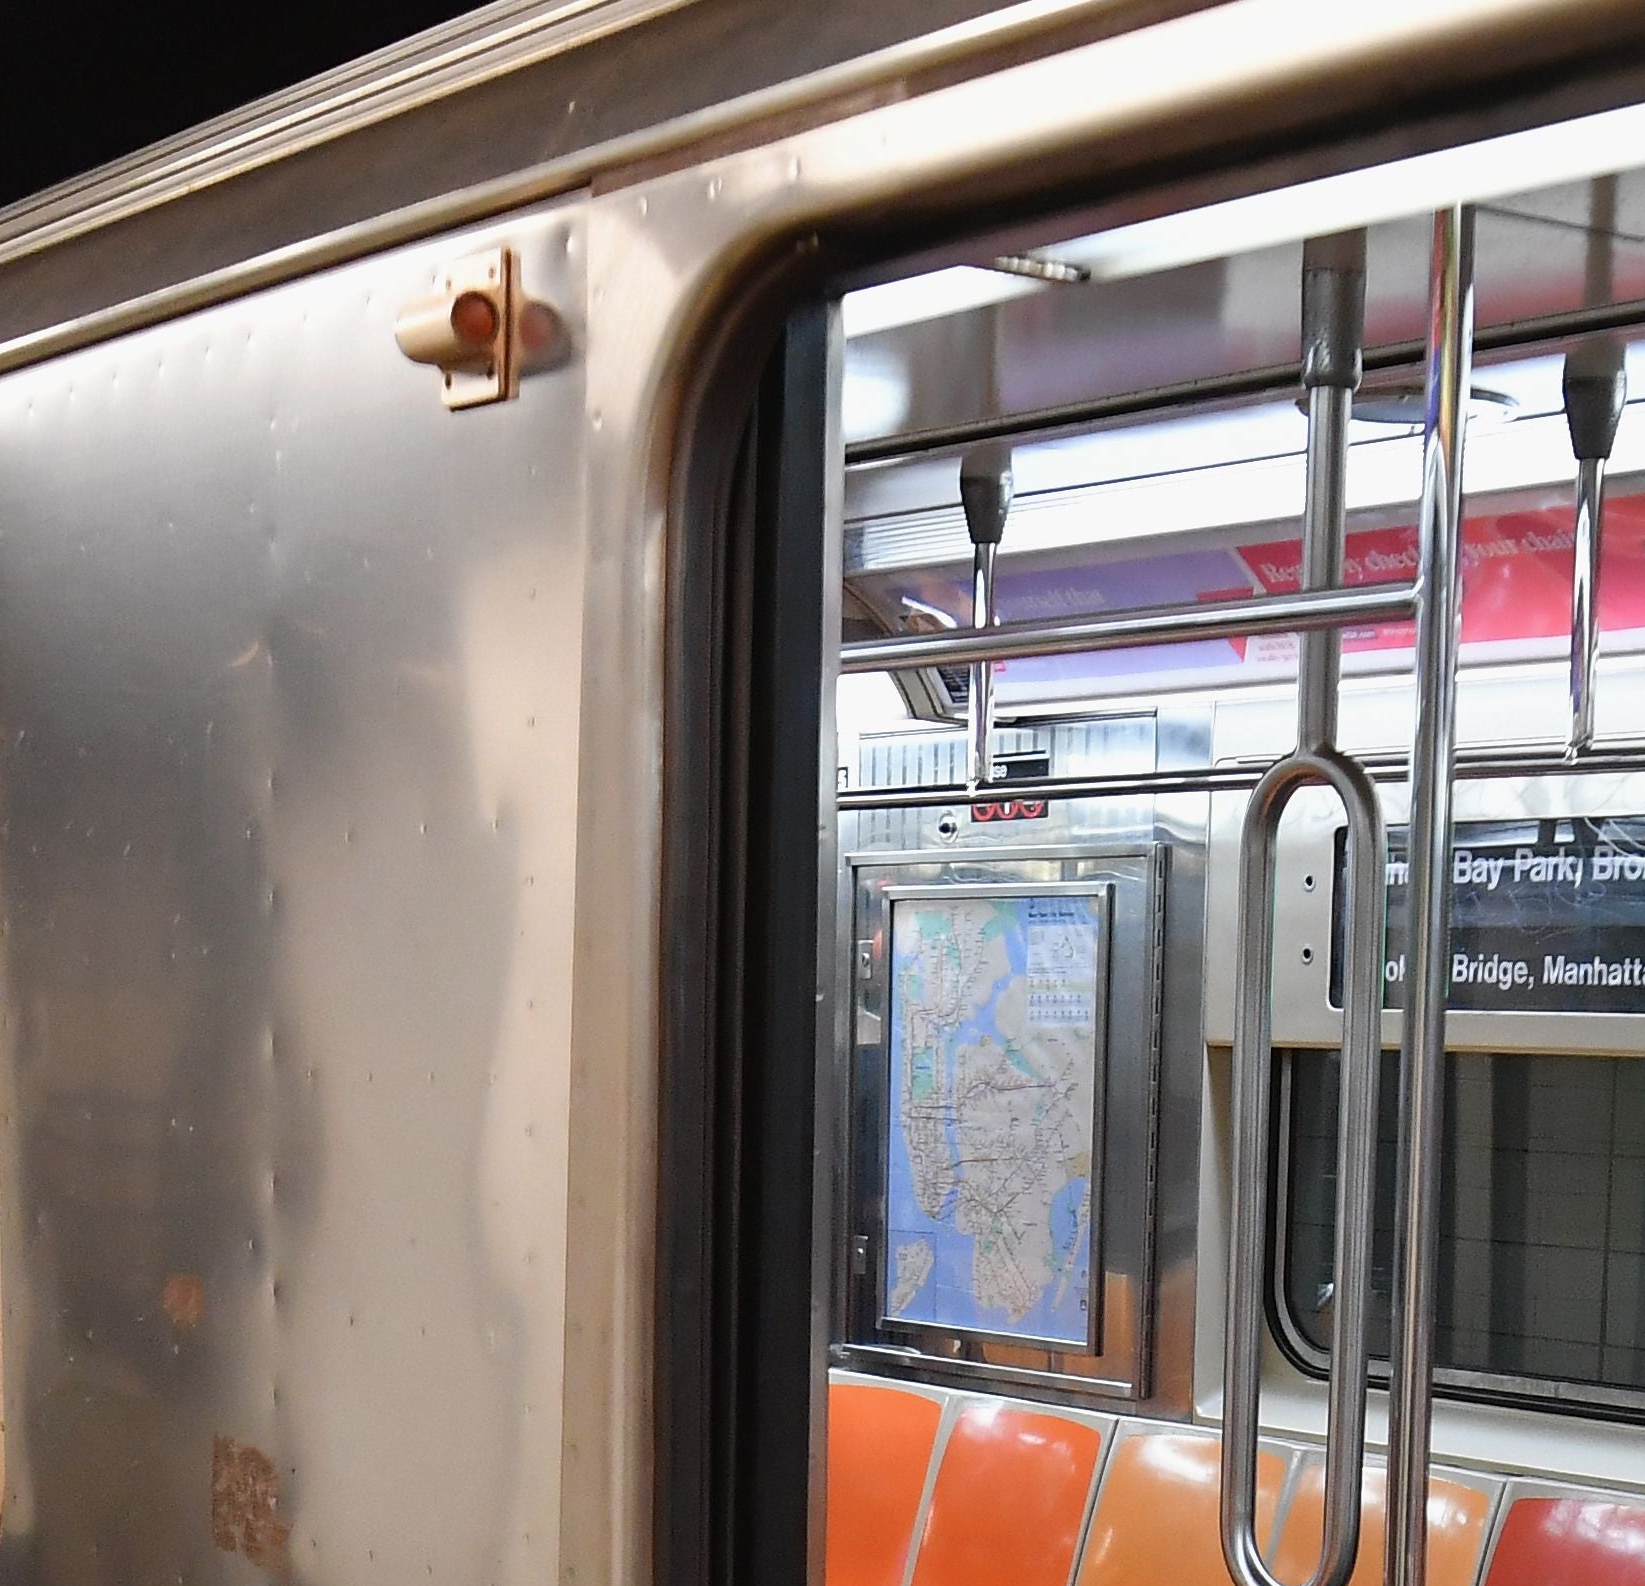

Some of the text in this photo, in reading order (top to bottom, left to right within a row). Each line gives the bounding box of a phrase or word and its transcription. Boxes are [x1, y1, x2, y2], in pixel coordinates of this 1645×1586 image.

[1454, 849, 1503, 891] Bay
[1513, 848, 1584, 889] Park,
[1453, 953, 1535, 991] Bridge,
